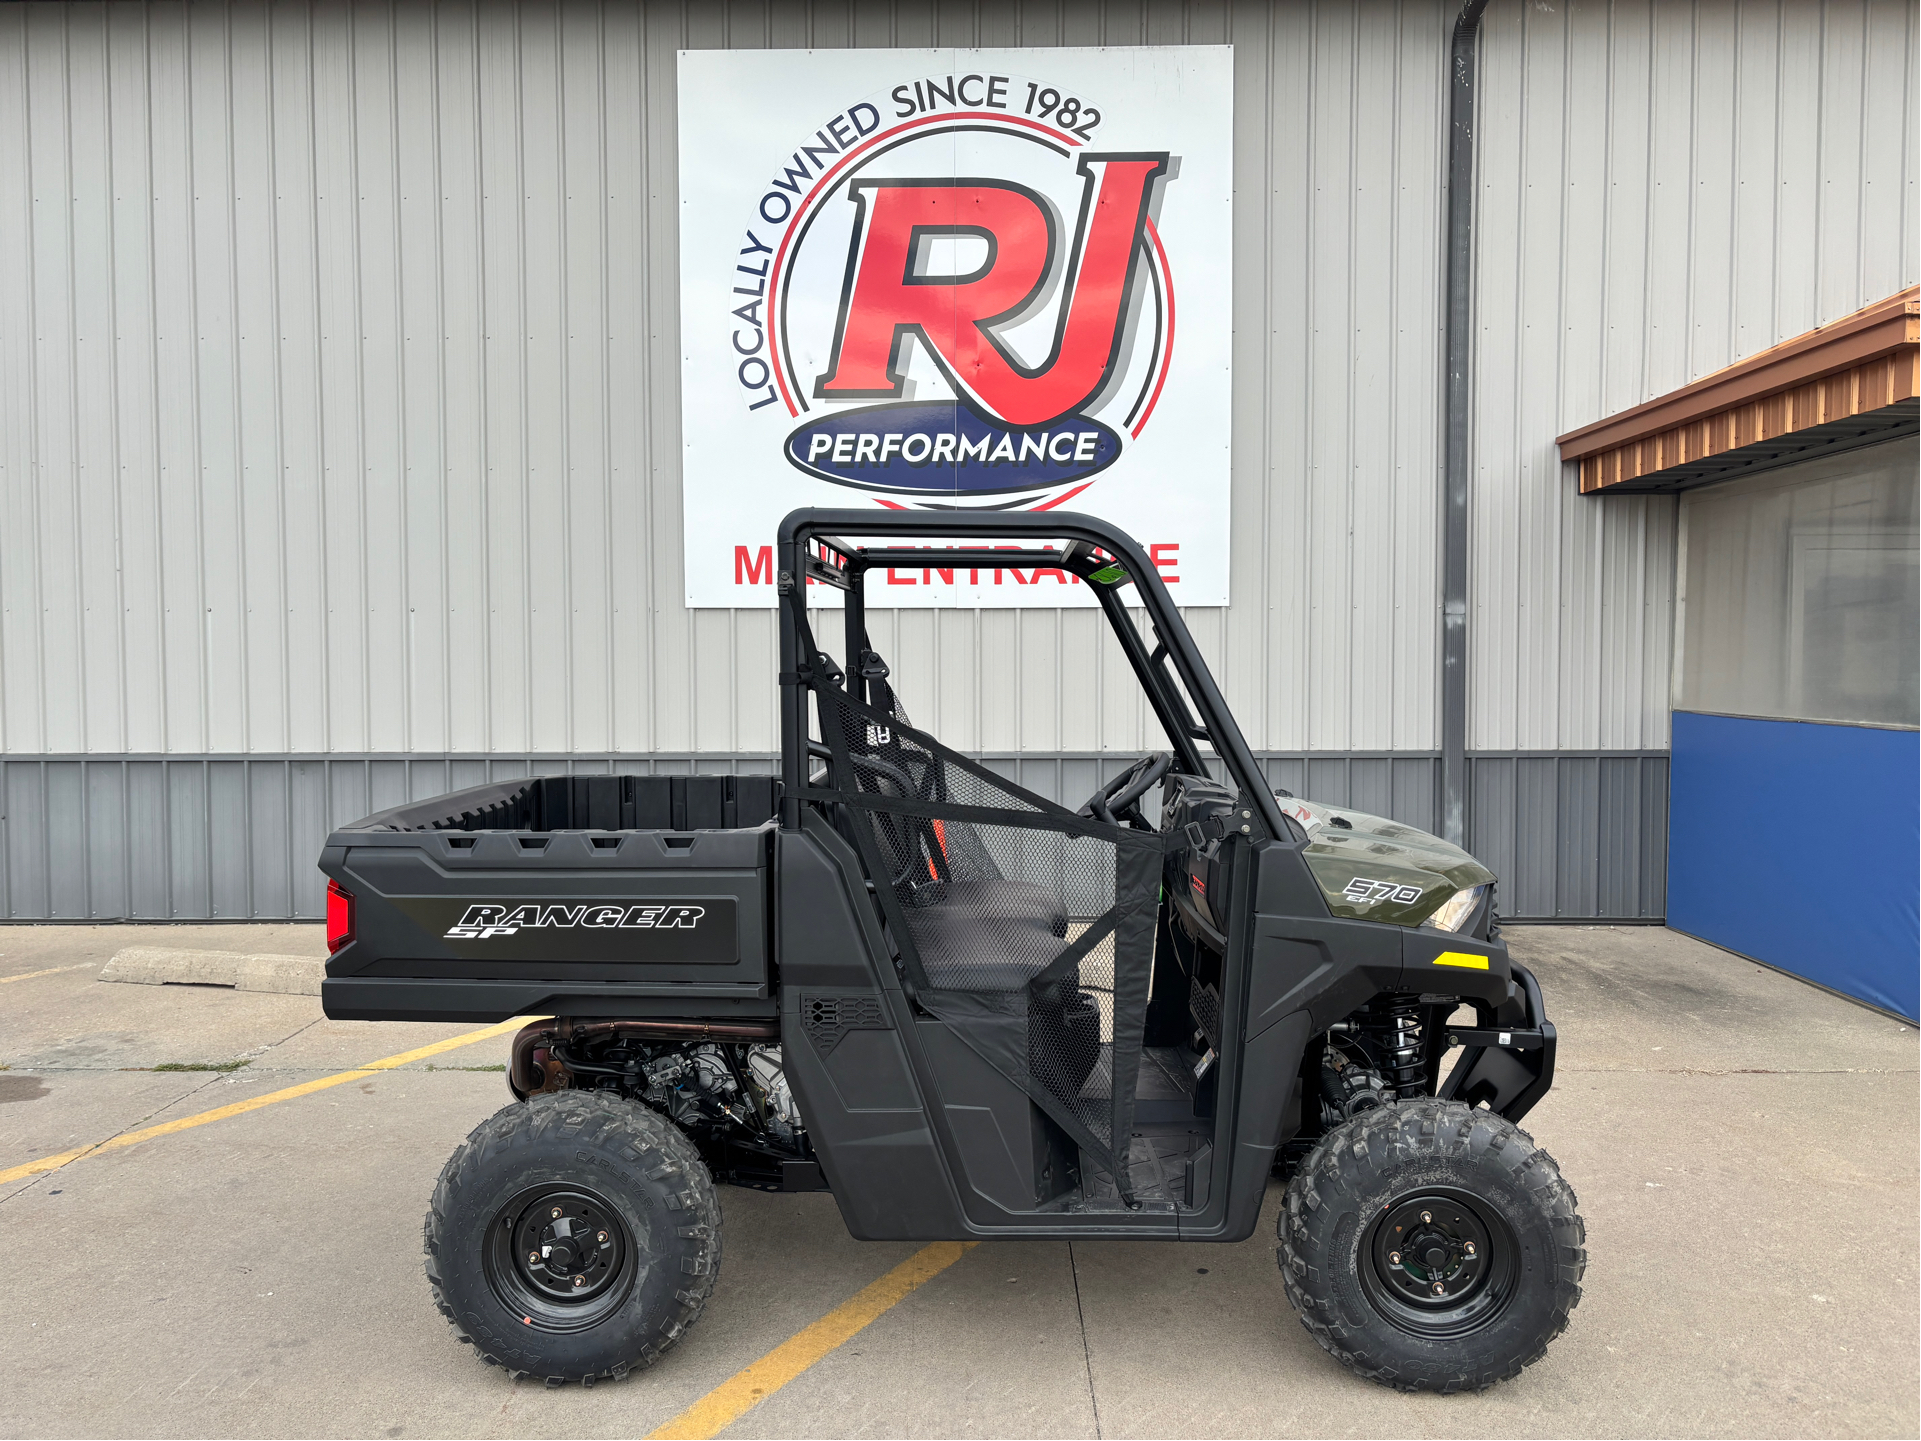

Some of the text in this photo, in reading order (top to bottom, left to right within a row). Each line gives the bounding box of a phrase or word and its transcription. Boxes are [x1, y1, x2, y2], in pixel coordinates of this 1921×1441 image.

[731, 74, 1102, 412] LOCALLY OWNED SINCE 1982
[813, 151, 1172, 434] RJ
[807, 431, 1099, 465] PERFORMANCE
[1341, 877, 1423, 905] 570
[1346, 895, 1376, 905] EFI
[457, 904, 705, 928] RANGER
[443, 926, 519, 938] SP
[575, 1150, 656, 1211] CARLSTAR
